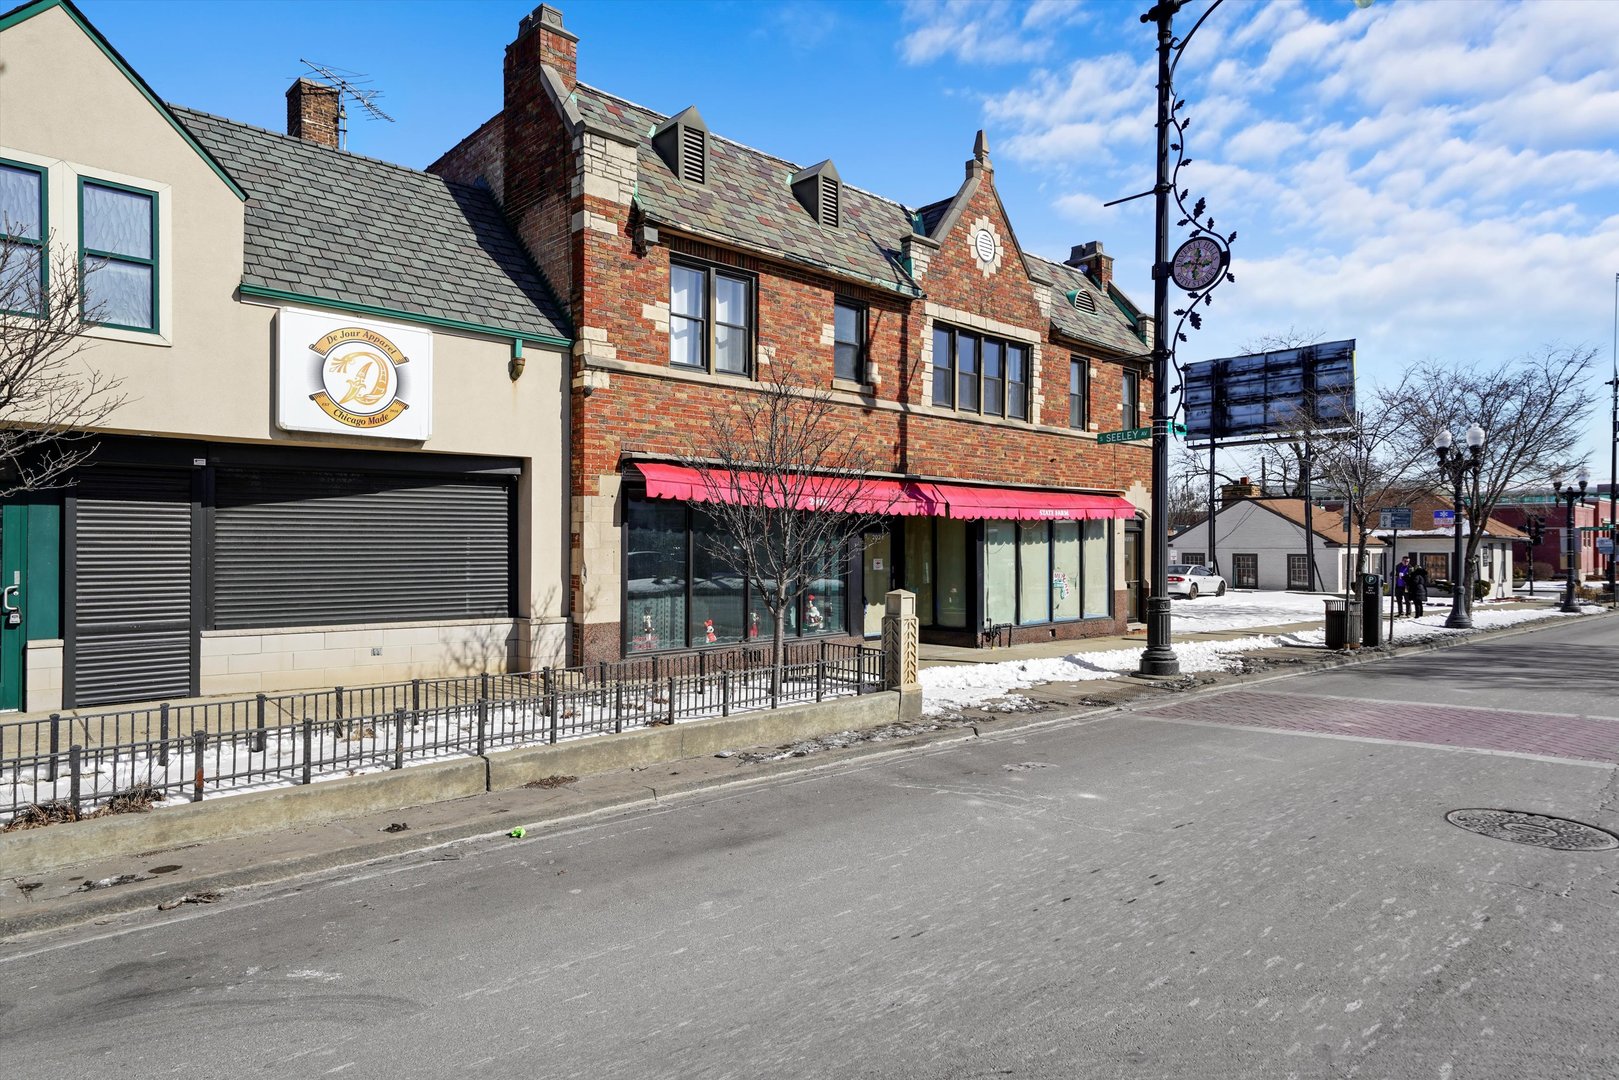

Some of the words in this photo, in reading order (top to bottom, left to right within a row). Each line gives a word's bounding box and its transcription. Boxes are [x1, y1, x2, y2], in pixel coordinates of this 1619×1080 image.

[1176, 241, 1202, 267] BEVERLY
[1203, 241, 1218, 261] HILLS
[1192, 267, 1217, 286] STREET
[326, 333, 338, 345] De
[340, 330, 361, 339] Jour
[362, 331, 397, 355] Apparel
[333, 408, 366, 427] Chicago
[368, 413, 389, 425] Made
[1106, 430, 1139, 442] SEELEY
